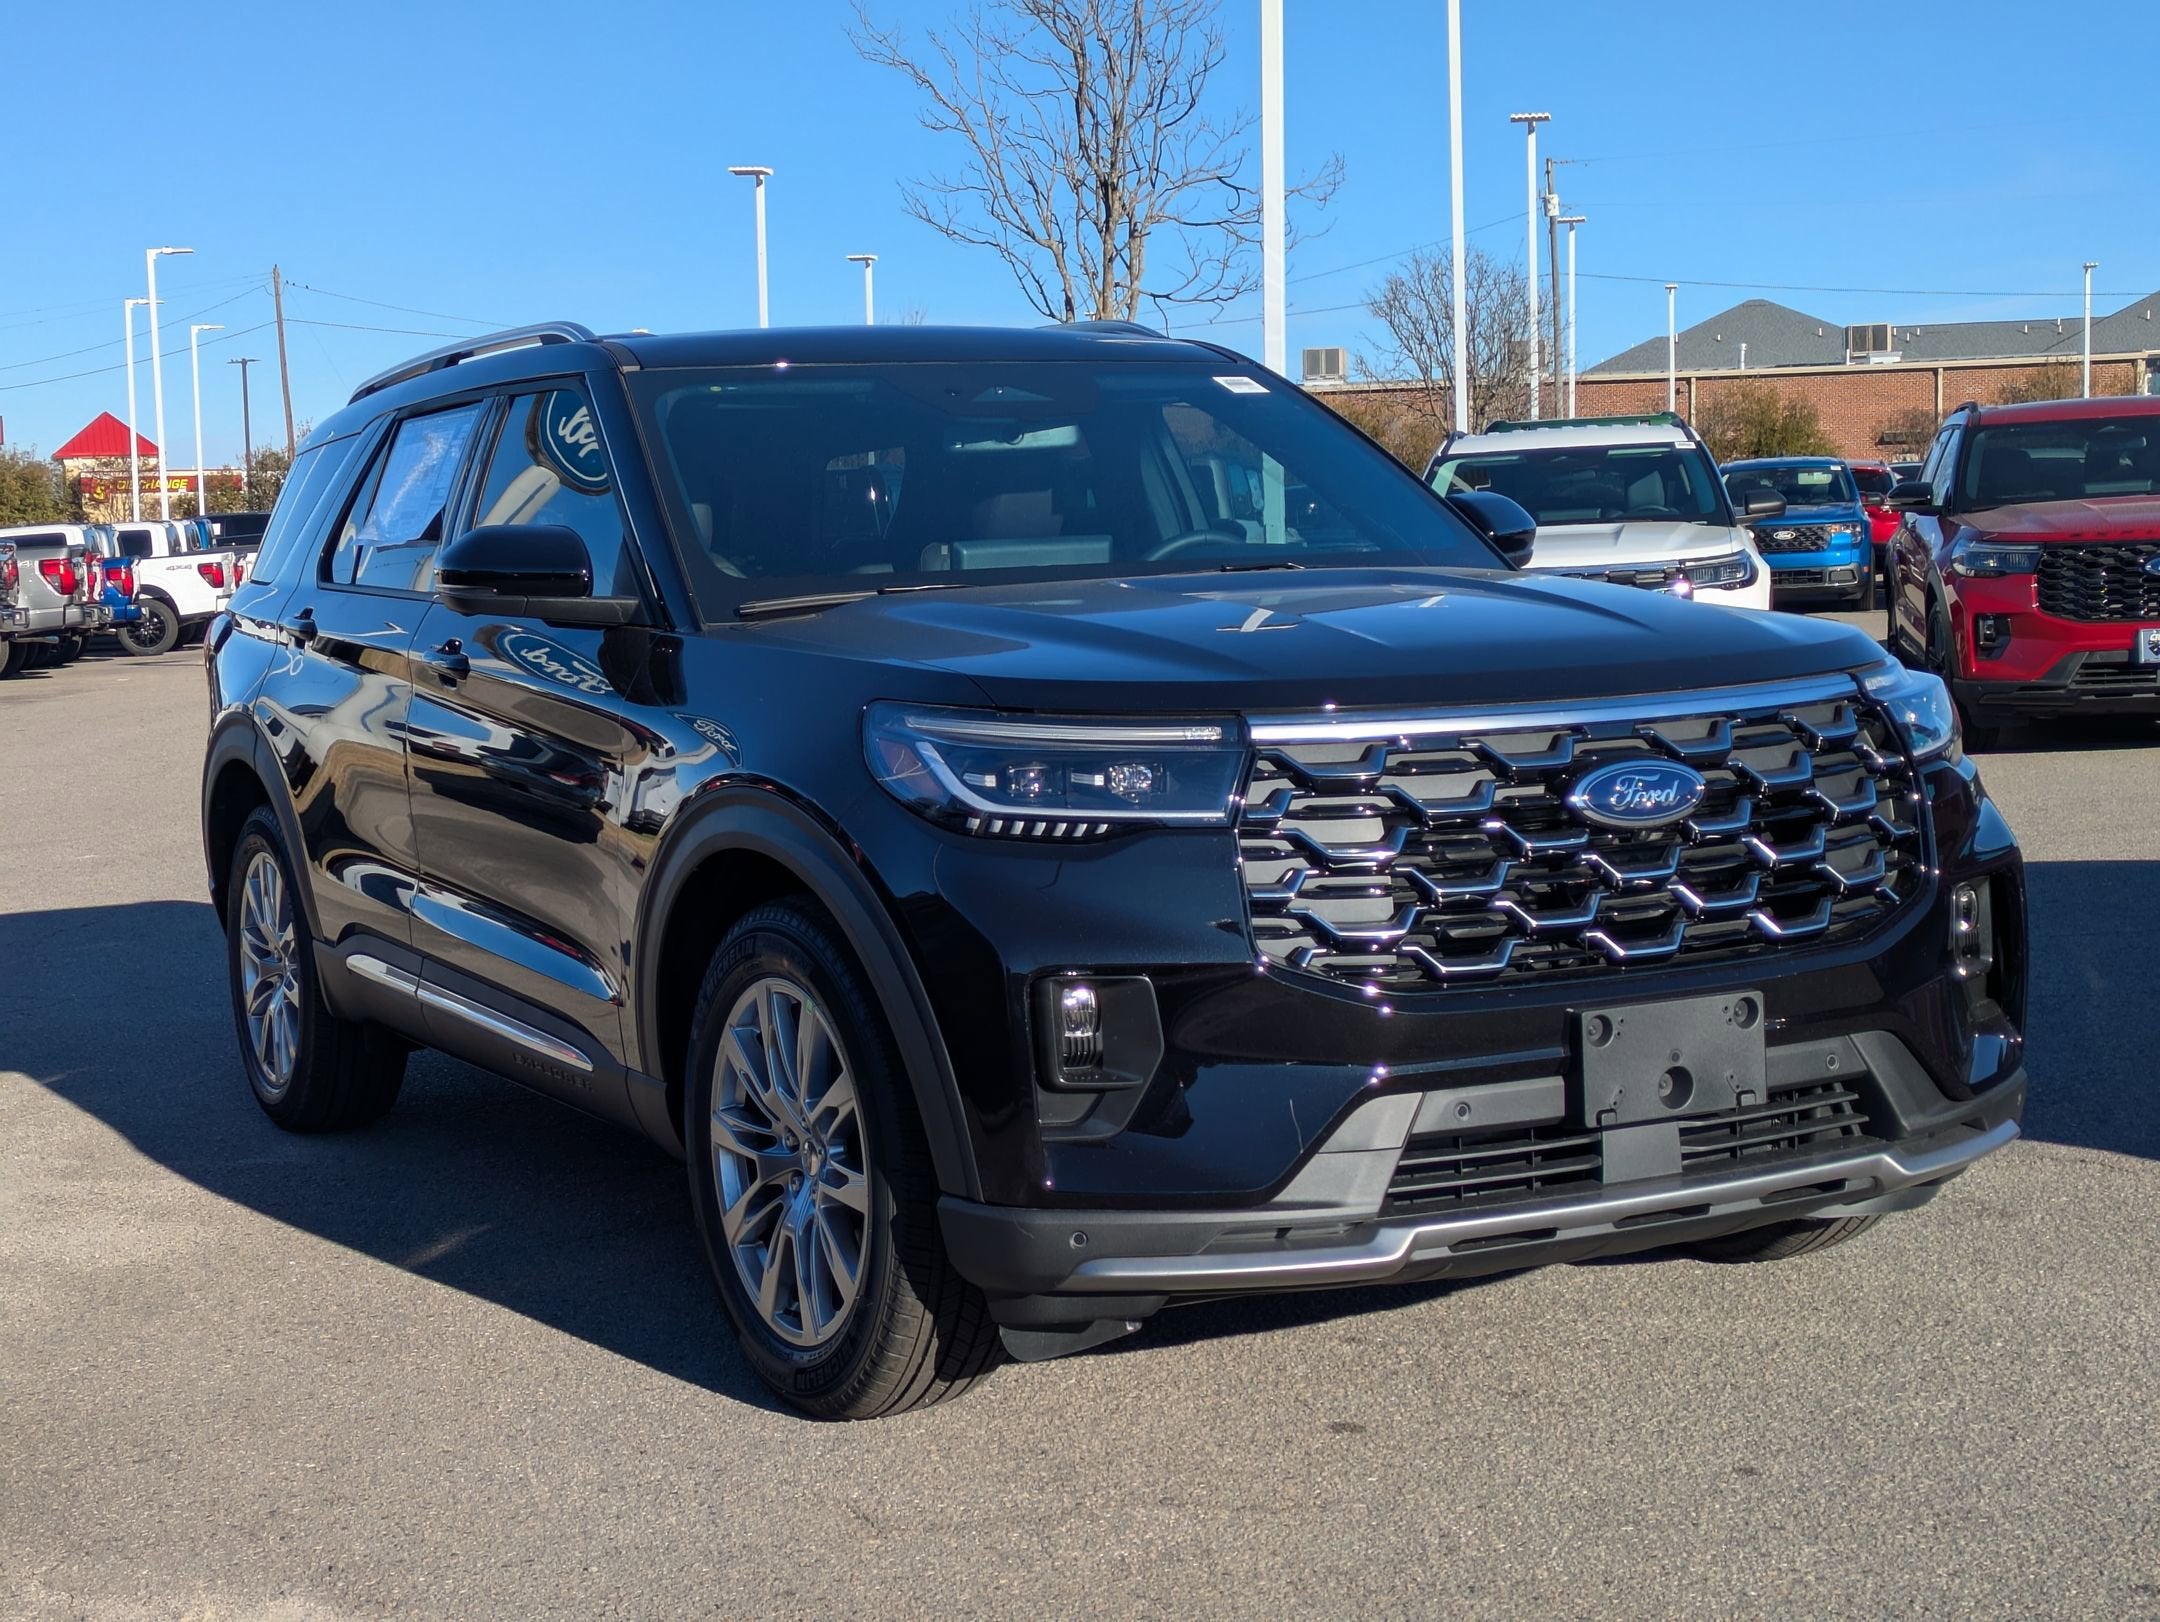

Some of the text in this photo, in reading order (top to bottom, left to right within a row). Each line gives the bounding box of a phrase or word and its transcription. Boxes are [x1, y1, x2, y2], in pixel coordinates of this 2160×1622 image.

[693, 719, 738, 752] Ford
[1610, 773, 1681, 811] Ford
[795, 1338, 854, 1390] MICHELIN
